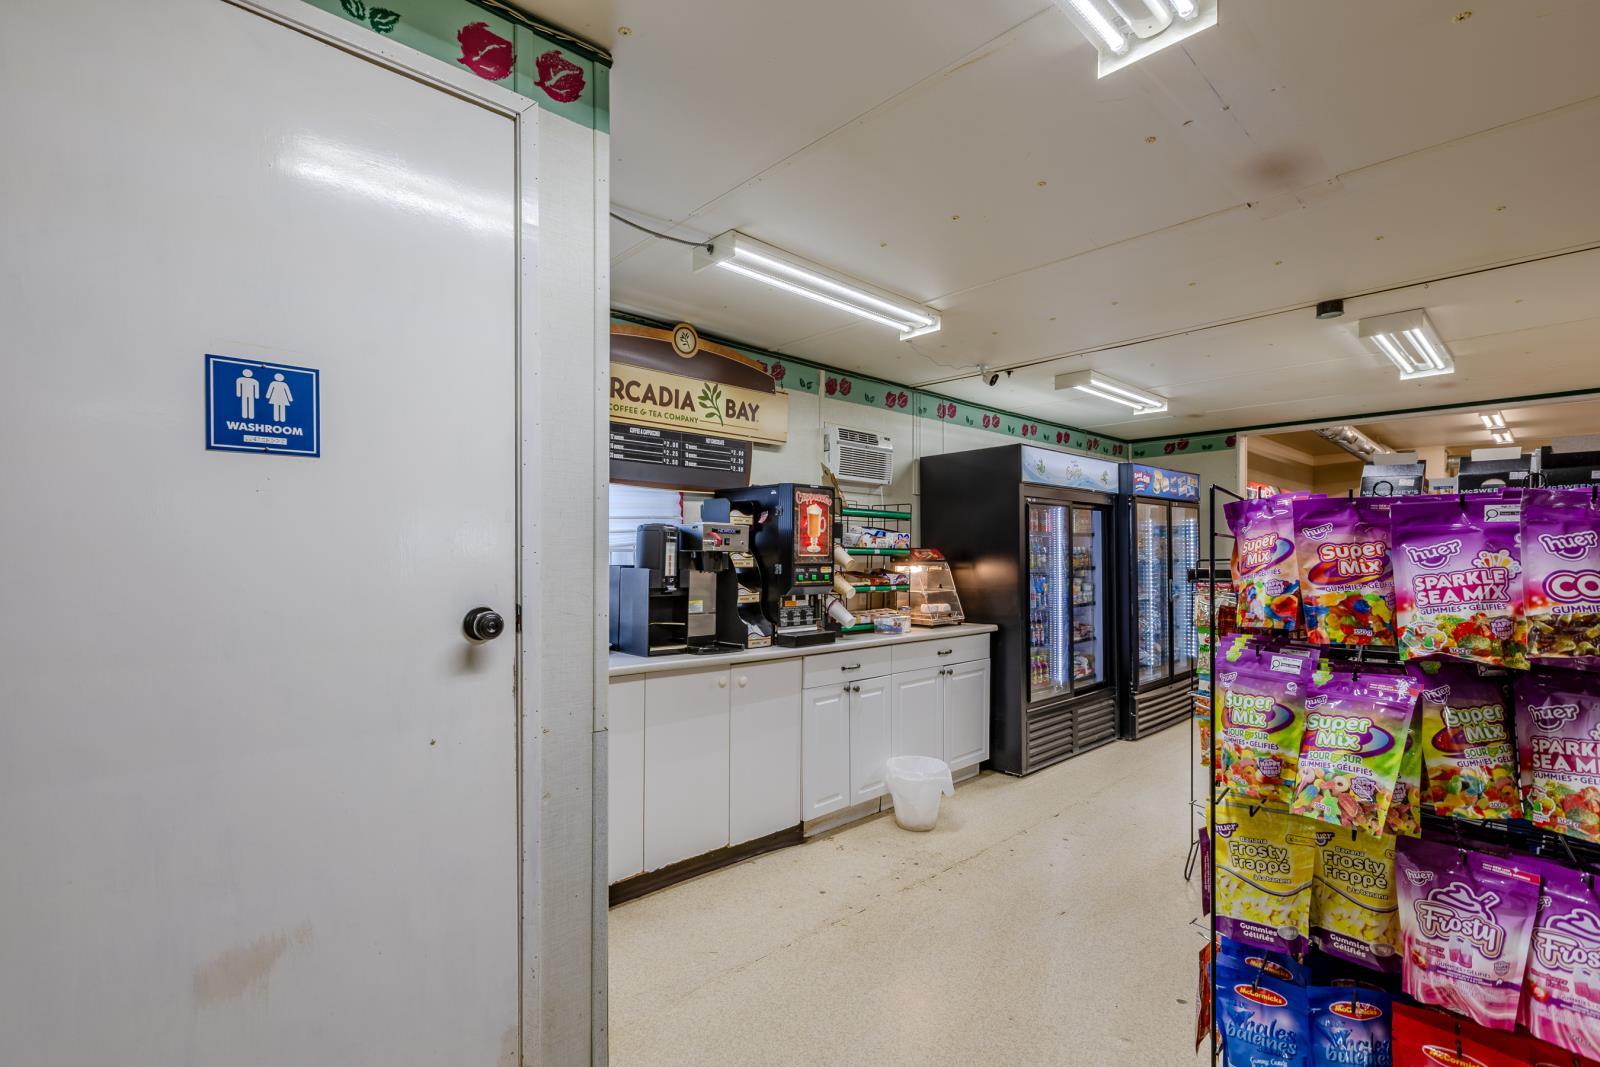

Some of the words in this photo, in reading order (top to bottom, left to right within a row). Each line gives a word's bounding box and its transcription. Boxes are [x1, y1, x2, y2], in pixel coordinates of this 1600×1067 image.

[640, 408, 647, 416] &
[649, 409, 662, 418] TEA
[664, 412, 699, 424] COMPANY
[725, 398, 760, 422] BAY
[226, 421, 303, 436] WASHROOM
[1304, 523, 1333, 538] huer
[1243, 534, 1277, 555] Super
[1320, 542, 1385, 560] Super
[1544, 532, 1595, 553] huer
[1247, 550, 1271, 566] Mix
[1409, 540, 1461, 564] huer
[1341, 559, 1382, 576] Mix
[1325, 584, 1363, 593] GUMMIES
[1415, 568, 1506, 591] SPARKLE
[1416, 588, 1464, 607] SEA
[1463, 585, 1506, 603] MIX
[1419, 606, 1462, 615] GUMMIES
[1225, 693, 1274, 711] Super
[1232, 709, 1266, 726] Mix
[1444, 704, 1503, 723] Super
[1531, 706, 1577, 721] huer
[1308, 714, 1371, 733] Super
[1466, 723, 1506, 741] Mix
[1254, 731, 1269, 740] SUR
[1317, 729, 1360, 750] Mix
[1309, 751, 1330, 761] SOUR
[1343, 753, 1362, 764] SUR
[1465, 746, 1488, 758] SOUR
[1300, 760, 1331, 769] GUMMIES
[1457, 757, 1493, 767] GUMMIES
[1532, 753, 1571, 770] SEA
[1533, 772, 1572, 782] GUMMIES
[1229, 841, 1288, 862] Frosty
[1231, 855, 1291, 874] Frappé
[1322, 850, 1385, 875] Frosty
[1323, 864, 1387, 889] Frappé
[1407, 870, 1433, 881] huer
[1239, 922, 1278, 937] Gummies
[1419, 904, 1496, 949] Frosty
[1329, 933, 1370, 952] Gummies
[1239, 986, 1283, 1004] McCormicks
[1226, 1020, 1297, 1056] baleines
